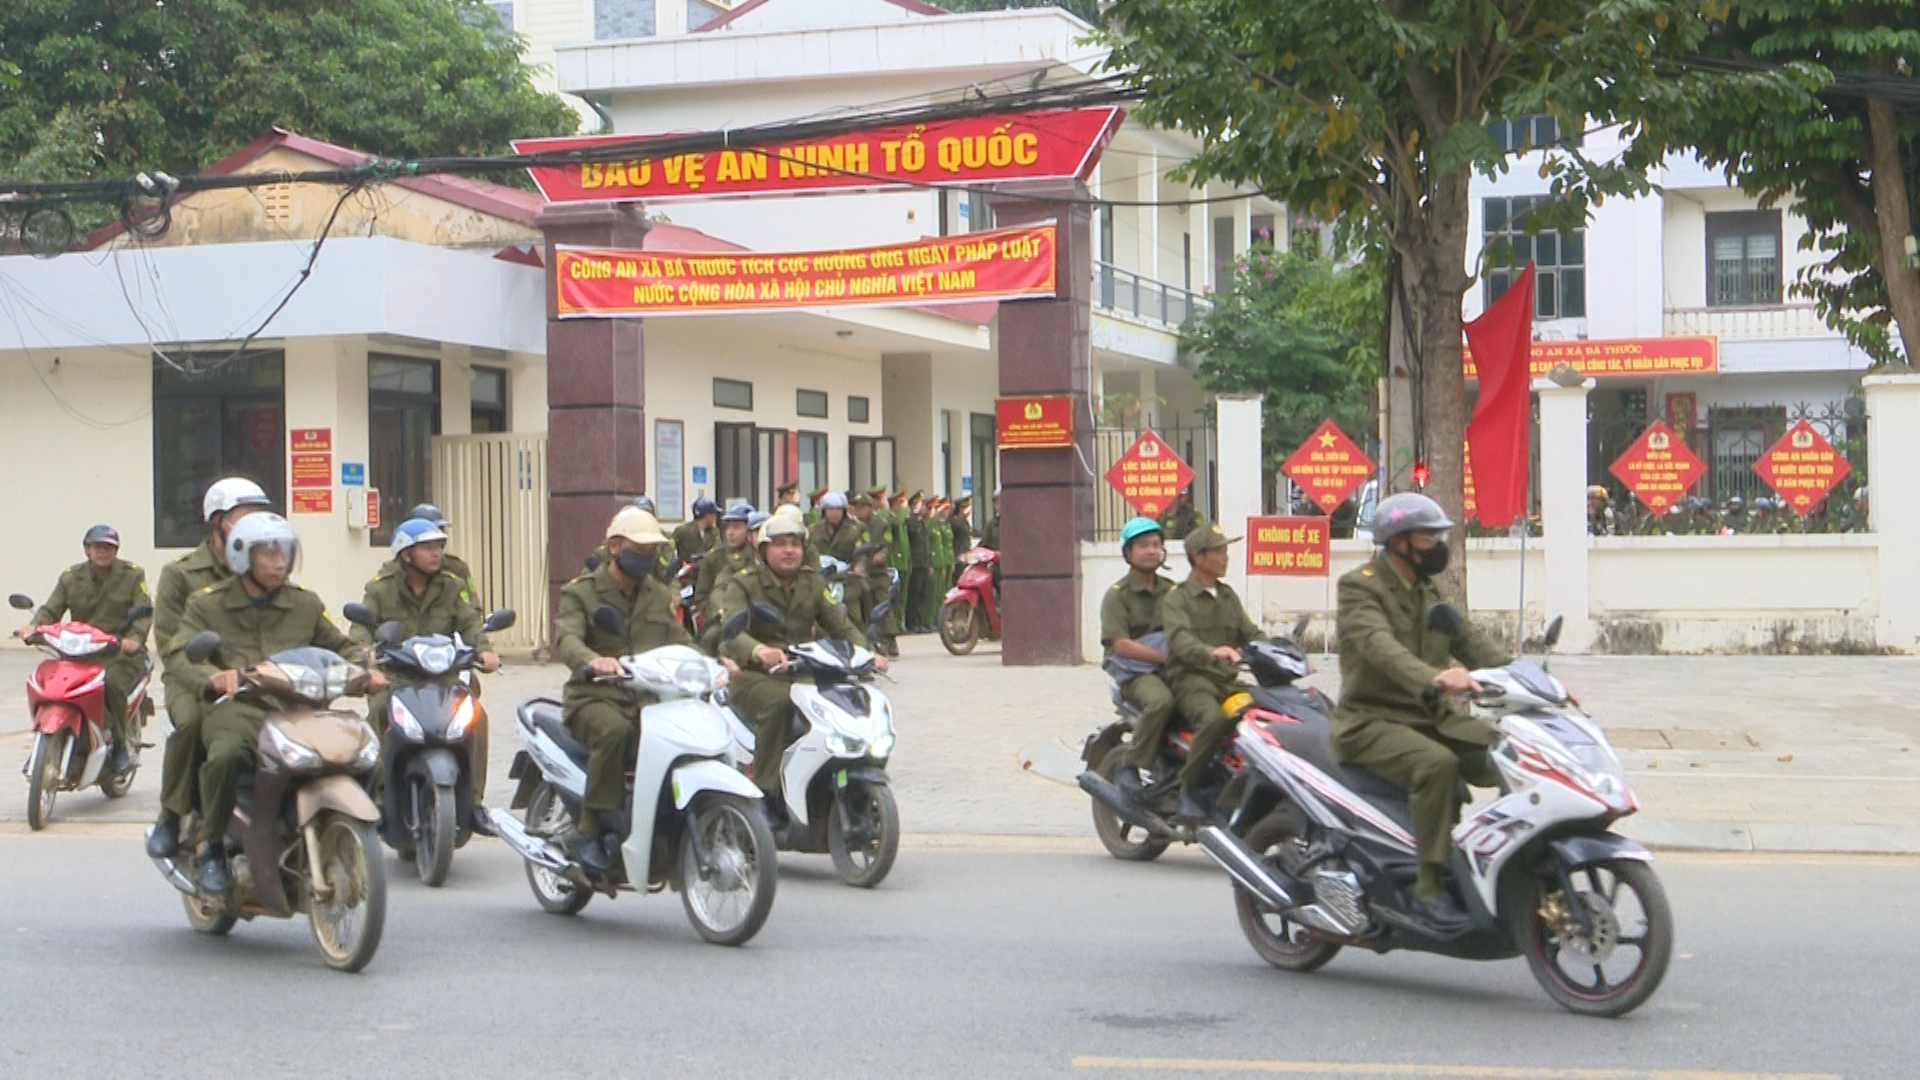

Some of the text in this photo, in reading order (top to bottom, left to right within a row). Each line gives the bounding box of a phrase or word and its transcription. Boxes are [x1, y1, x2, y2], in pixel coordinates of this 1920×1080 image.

[716, 147, 767, 184] AN
[779, 143, 869, 179] NINH
[881, 123, 925, 173] TỔ
[938, 121, 1038, 173] QUỐC
[571, 257, 612, 279] CÔNG
[615, 260, 637, 278] AN
[1001, 235, 1041, 262] LUẬT
[633, 280, 674, 304] NƯỚC
[678, 281, 720, 306] CỘNG
[784, 277, 810, 303] HỘI
[849, 273, 897, 296] NGHĨA
[901, 269, 934, 297] VIỆT
[937, 269, 976, 292] NAM
[1257, 525, 1291, 543] KHÔNG
[1307, 529, 1321, 544] XE
[1253, 551, 1274, 567] KHU
[1275, 551, 1295, 570] VỰC
